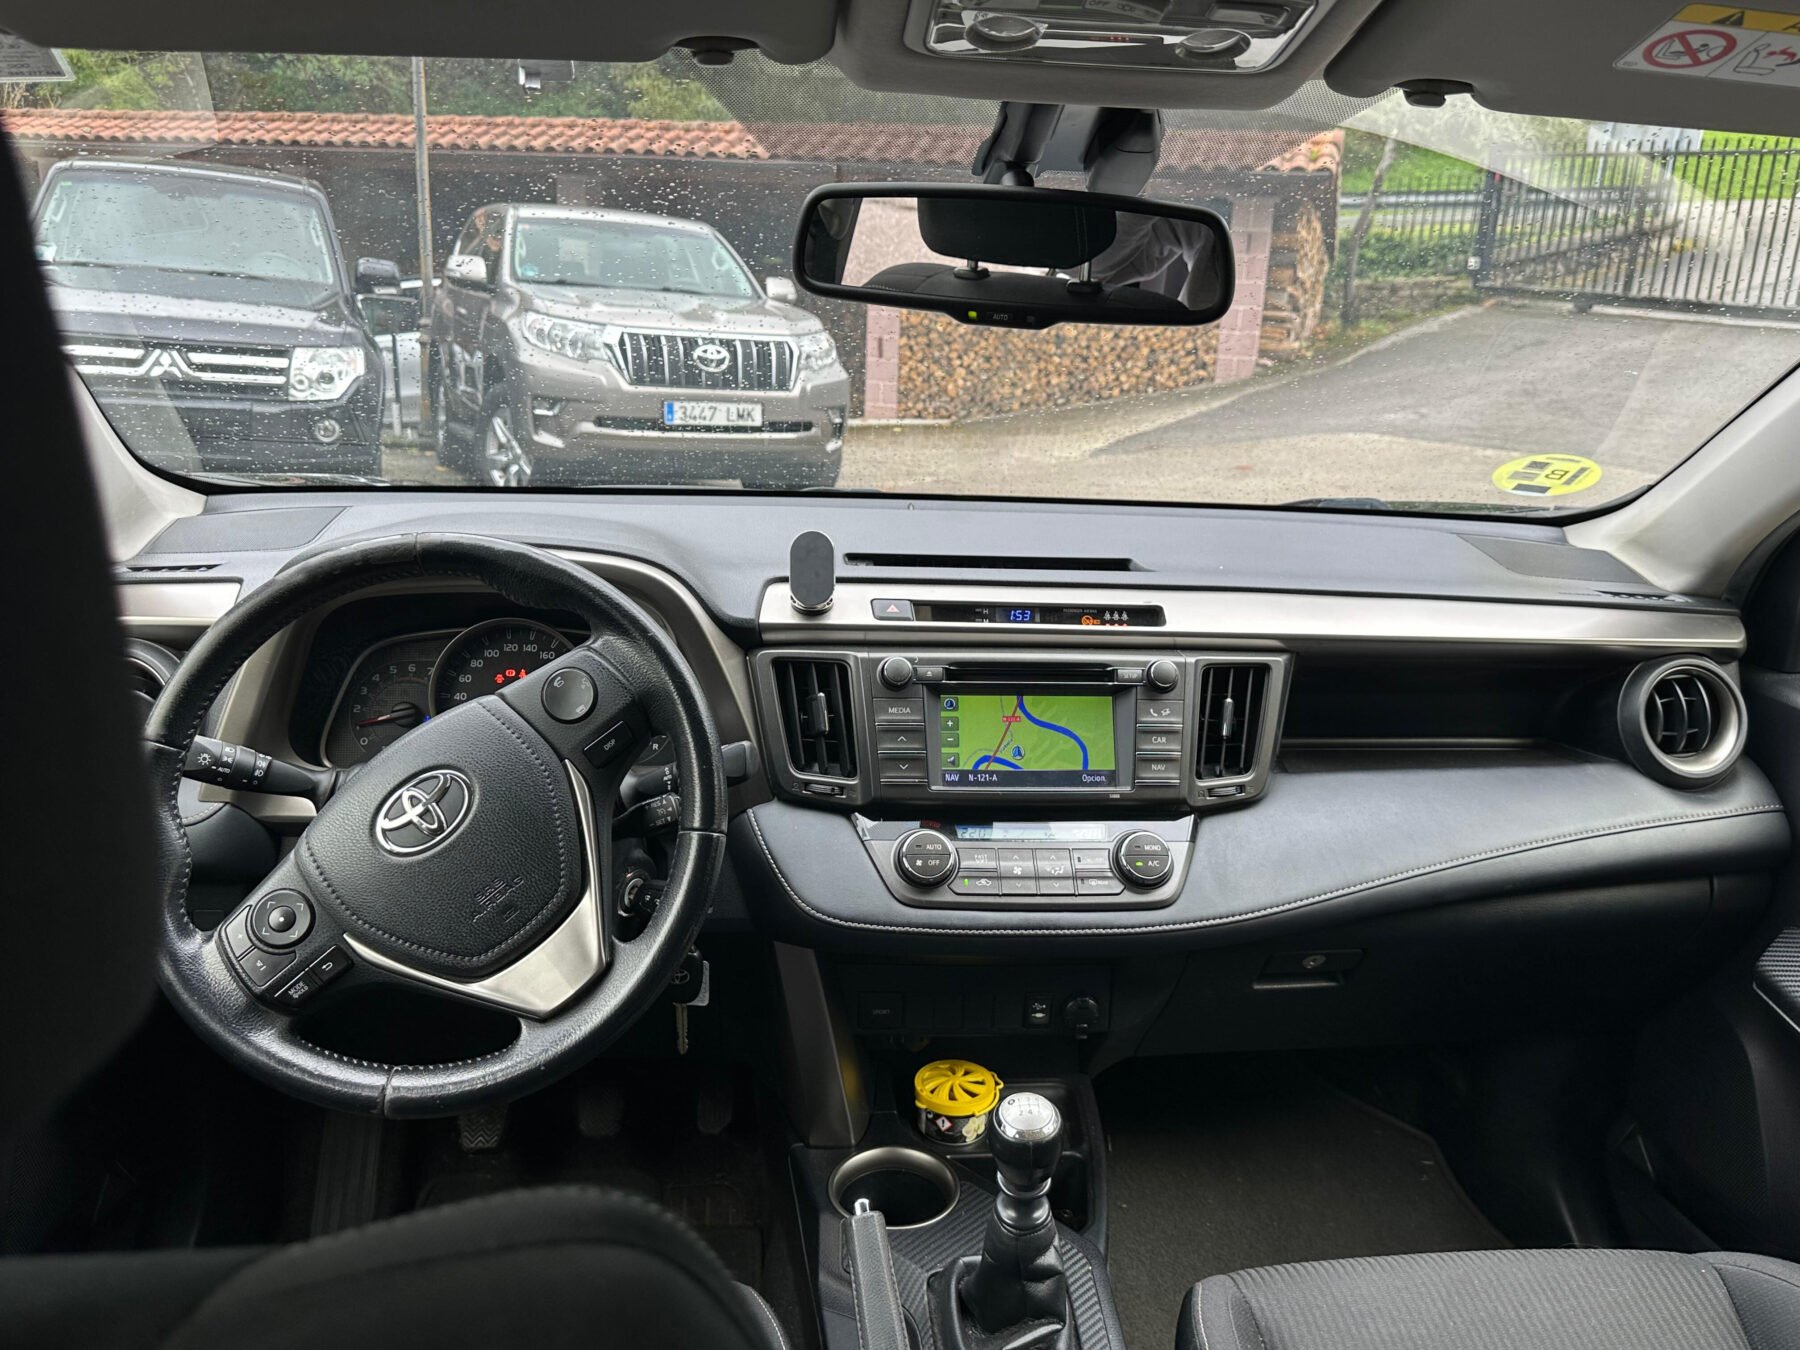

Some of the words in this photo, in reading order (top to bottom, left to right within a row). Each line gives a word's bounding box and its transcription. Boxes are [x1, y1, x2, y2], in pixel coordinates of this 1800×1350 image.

[992, 313, 1009, 321] AUTO
[679, 405, 718, 421] 3447
[726, 406, 755, 422] LMK
[1544, 469, 1570, 481] B
[503, 643, 518, 652] 120
[523, 644, 538, 653] 140
[484, 649, 500, 658] 100
[539, 651, 555, 660] 160
[408, 663, 416, 672] 6
[470, 659, 484, 668] 80
[389, 665, 398, 674] 5
[372, 673, 380, 682] 4
[458, 674, 472, 683] 60
[360, 686, 368, 695] 3
[453, 692, 468, 701] 40
[353, 704, 361, 713] 2
[888, 706, 911, 714] MEDIA
[360, 737, 369, 746] 0
[603, 738, 616, 751] DISP
[1151, 736, 1167, 744] CAR
[217, 766, 231, 774] AUTO
[1151, 763, 1166, 771] NAV
[945, 773, 960, 781] NAV
[968, 773, 998, 781] N-121-A
[287, 980, 305, 995] MODE
